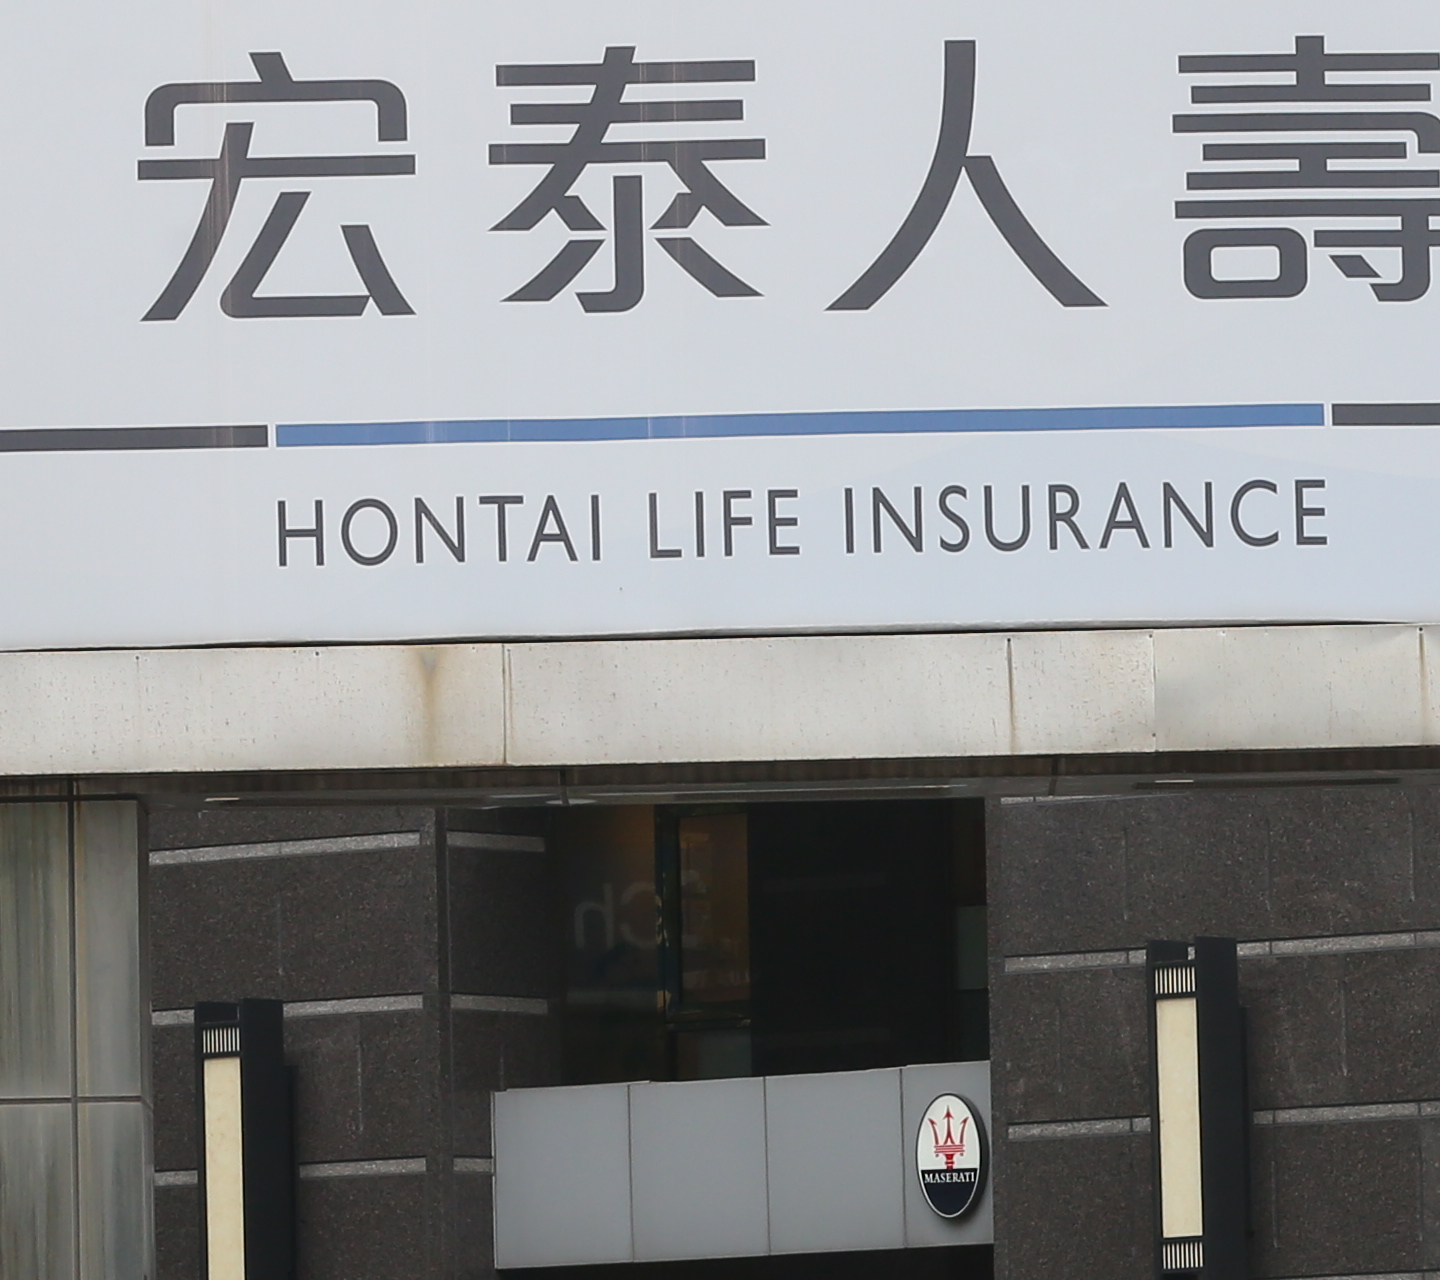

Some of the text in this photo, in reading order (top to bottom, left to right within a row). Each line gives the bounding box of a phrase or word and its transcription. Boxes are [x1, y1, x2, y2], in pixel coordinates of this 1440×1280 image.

[278, 479, 1328, 566] HONTAI LIFE INSURANCE
[924, 1171, 975, 1184] MASERATI
